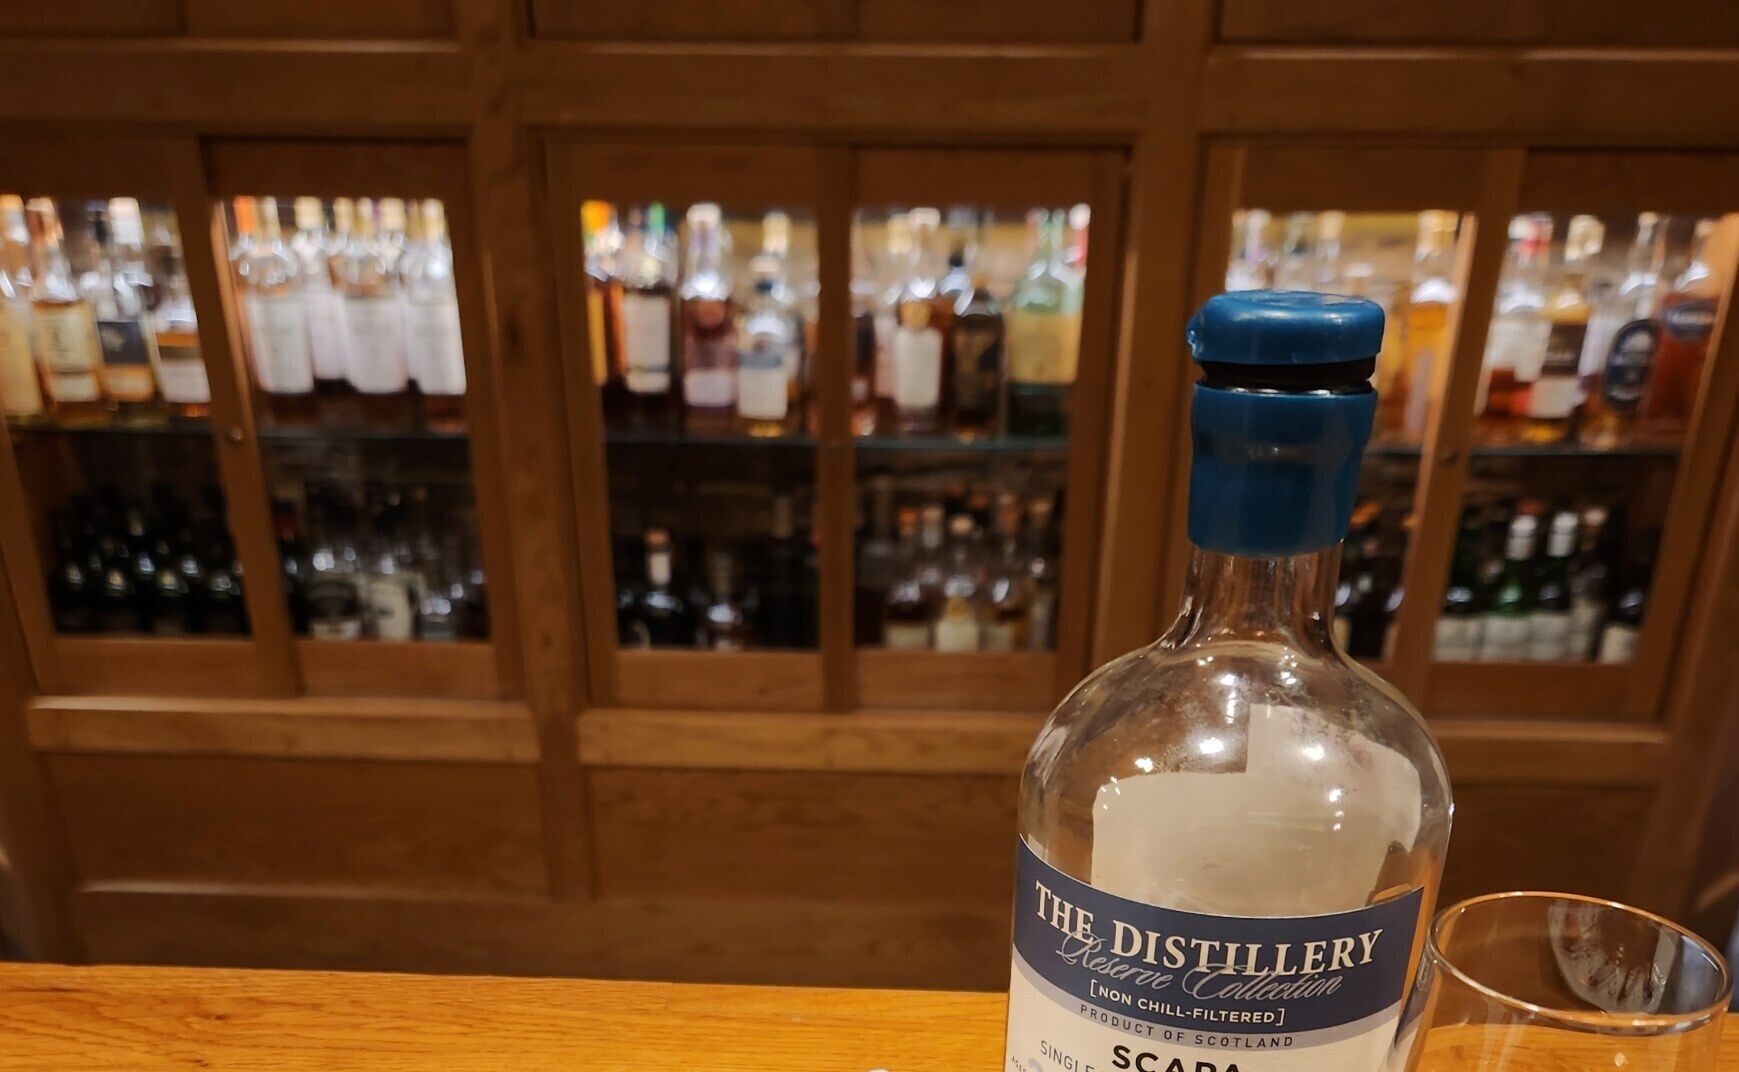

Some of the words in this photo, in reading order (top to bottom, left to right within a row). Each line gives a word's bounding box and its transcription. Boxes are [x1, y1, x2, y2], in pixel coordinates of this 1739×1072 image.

[1035, 880, 1094, 945] THE
[1111, 920, 1383, 976] DISTILLERY
[1056, 931, 1173, 989] Reserve
[1182, 963, 1343, 1000] Collection
[1080, 1004, 1154, 1036] PRODUCT
[1164, 1029, 1185, 1042] OF
[1194, 1034, 1293, 1048] SCOTLAND
